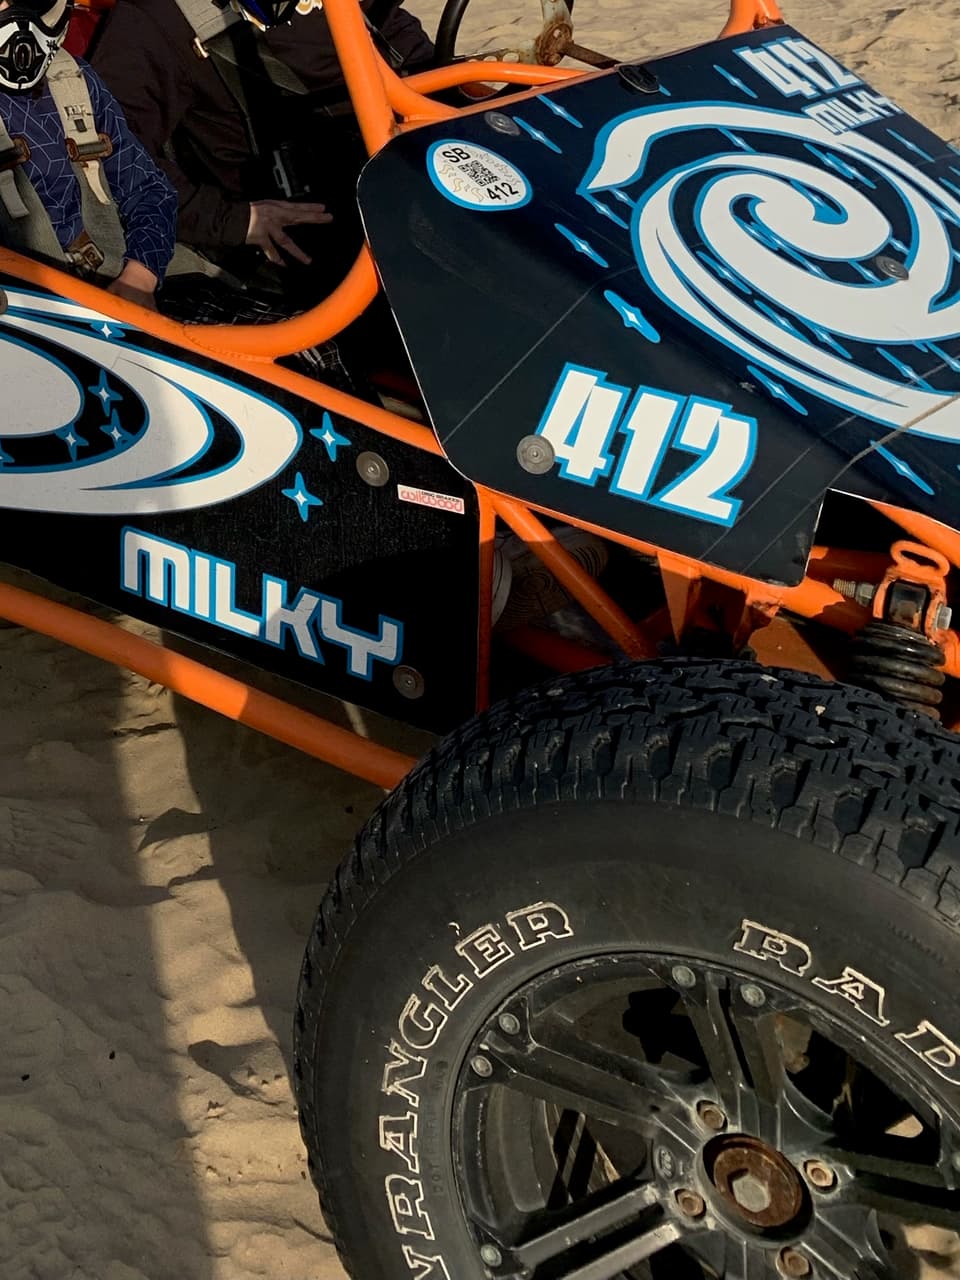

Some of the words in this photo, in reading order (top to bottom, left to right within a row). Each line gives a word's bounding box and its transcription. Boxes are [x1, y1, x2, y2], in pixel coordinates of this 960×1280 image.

[734, 37, 864, 99] 412
[442, 148, 471, 163] SB
[486, 182, 519, 200] 412
[536, 362, 758, 528] 412
[120, 526, 404, 682] MILKY
